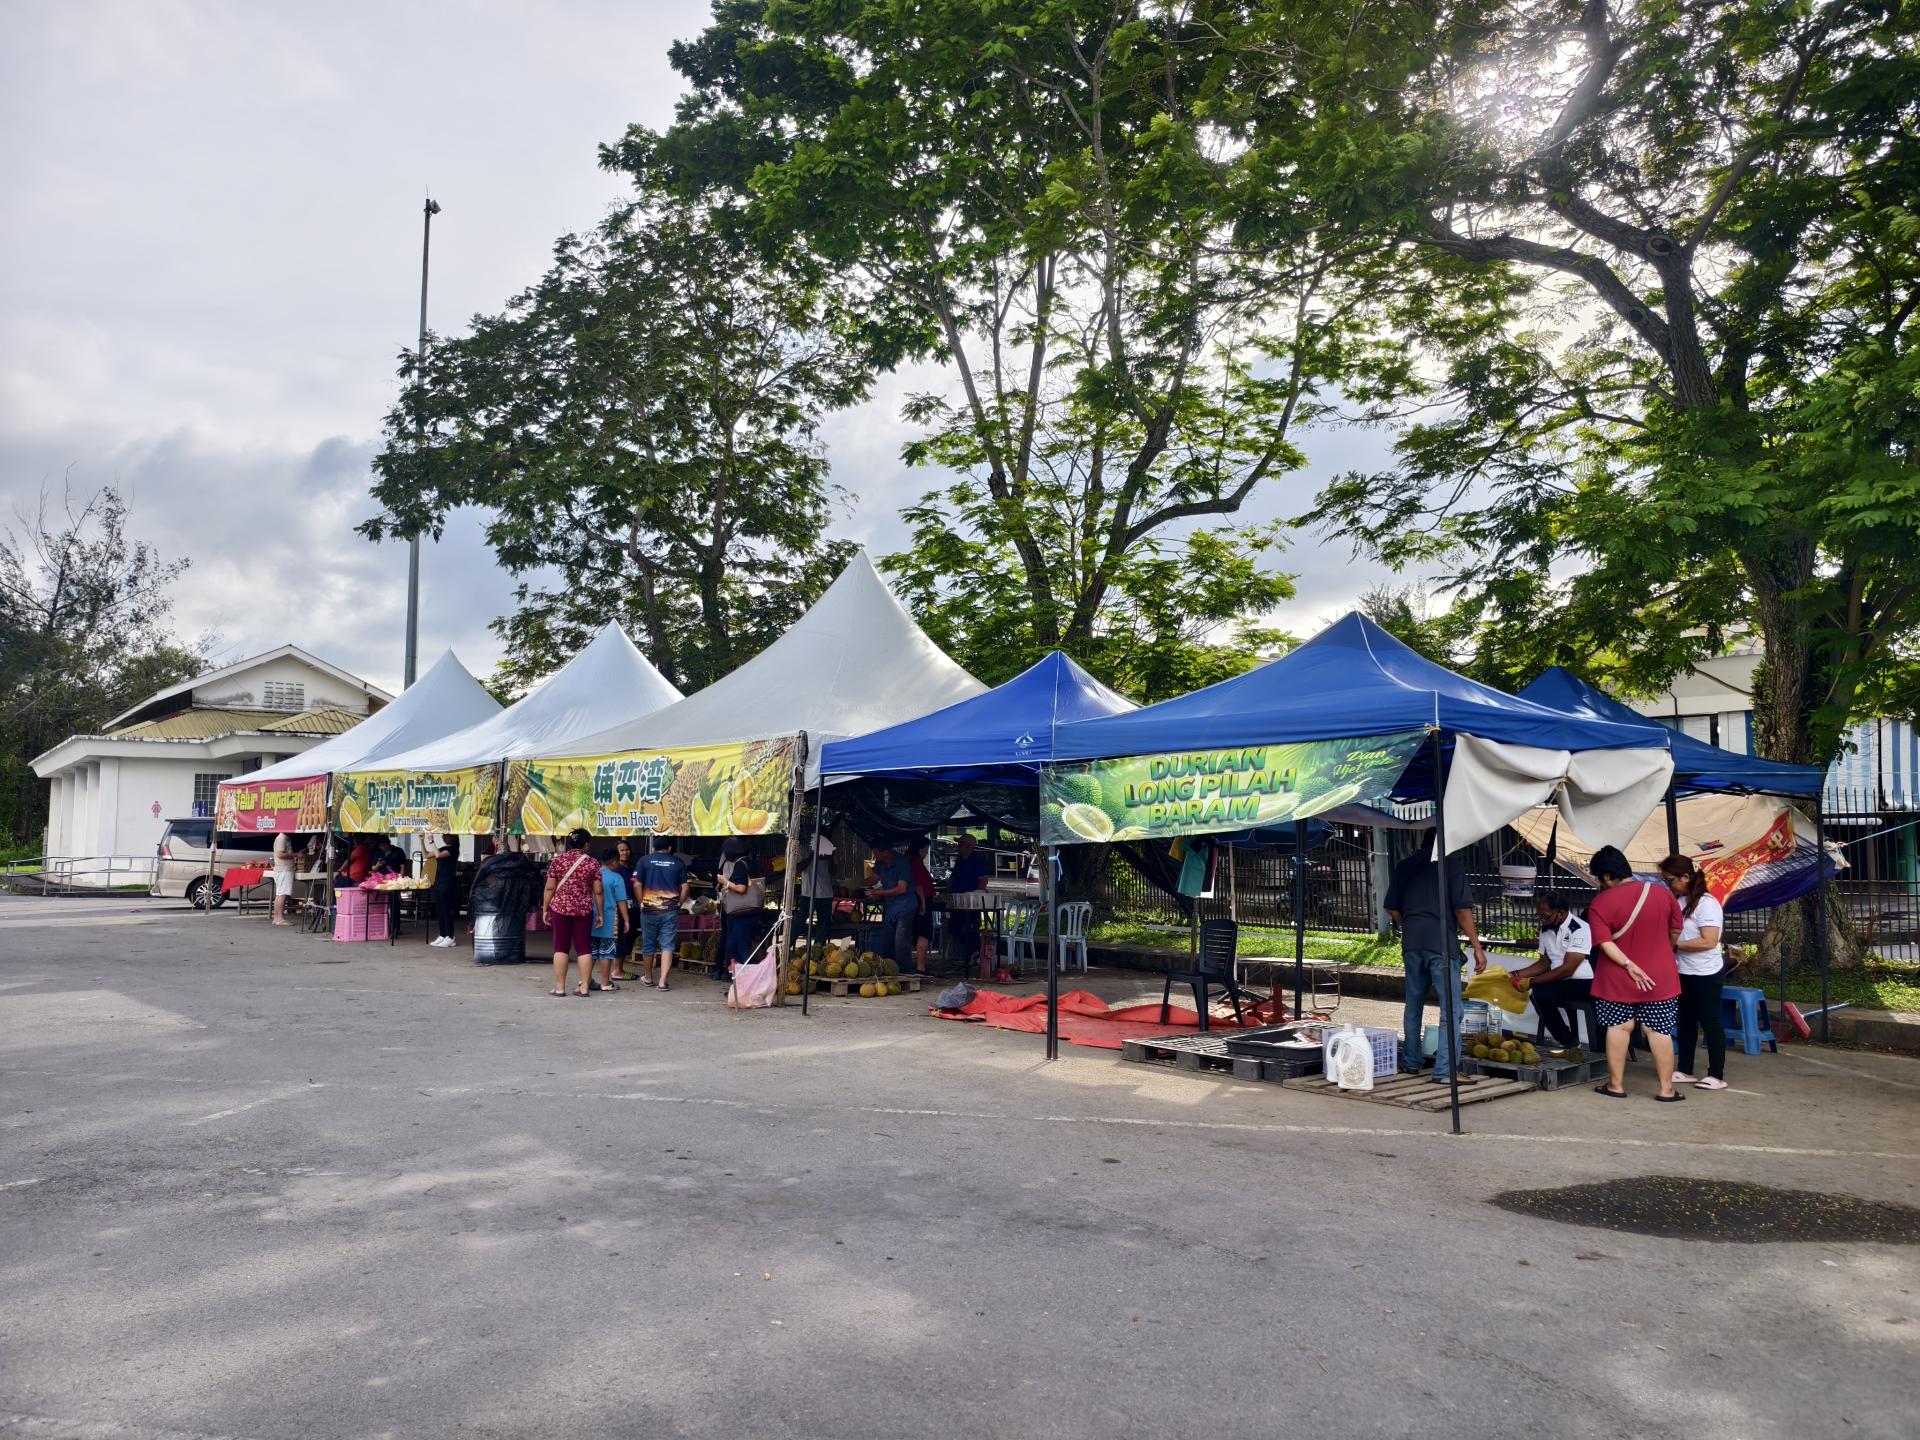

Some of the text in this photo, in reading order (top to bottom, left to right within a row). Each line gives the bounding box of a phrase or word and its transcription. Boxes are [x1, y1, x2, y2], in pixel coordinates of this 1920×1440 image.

[1151, 748, 1267, 780] DURIAN
[594, 758, 666, 804] 埔奕湾
[1124, 768, 1297, 808] LONG PILAH
[236, 786, 304, 816] Telur Tempatan
[368, 779, 457, 817] Pujut Corner
[1150, 796, 1261, 829] BARAM
[598, 811, 658, 827] Durian House
